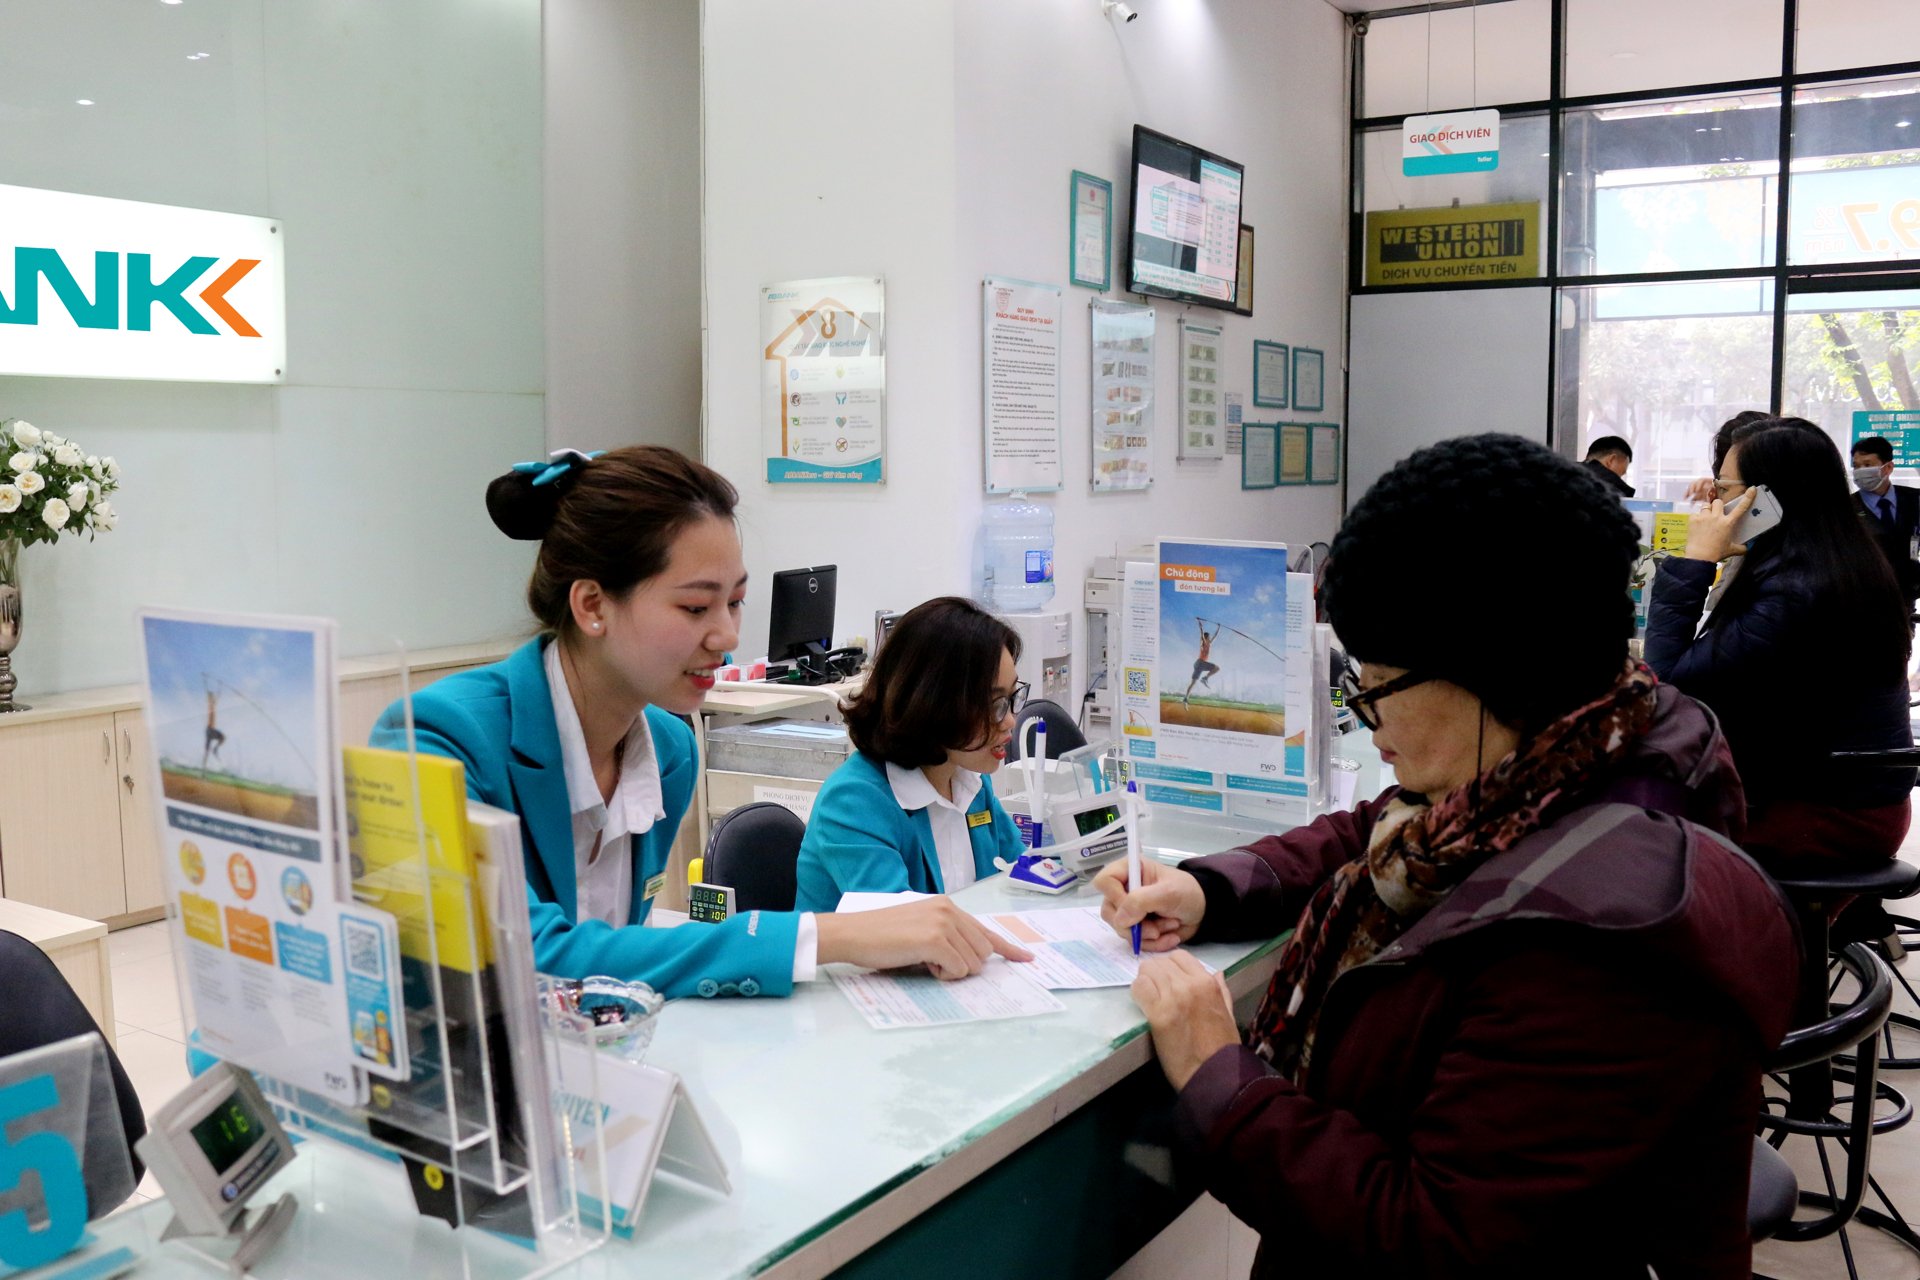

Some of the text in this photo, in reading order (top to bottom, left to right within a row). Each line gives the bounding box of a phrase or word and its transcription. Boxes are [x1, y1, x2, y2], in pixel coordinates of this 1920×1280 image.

[1409, 127, 1491, 144] GIAO DỊCH VIÊN
[1382, 222, 1500, 245] WESTERN
[1416, 239, 1500, 260] UNION
[0, 246, 221, 337] NK
[1165, 567, 1210, 581] Chủ động
[1194, 584, 1216, 593] tương
[1260, 763, 1277, 772] FWD
[717, 892, 725, 905] 0
[711, 910, 726, 922] 100
[218, 1105, 250, 1143] 16
[0, 1073, 89, 1270] 5
